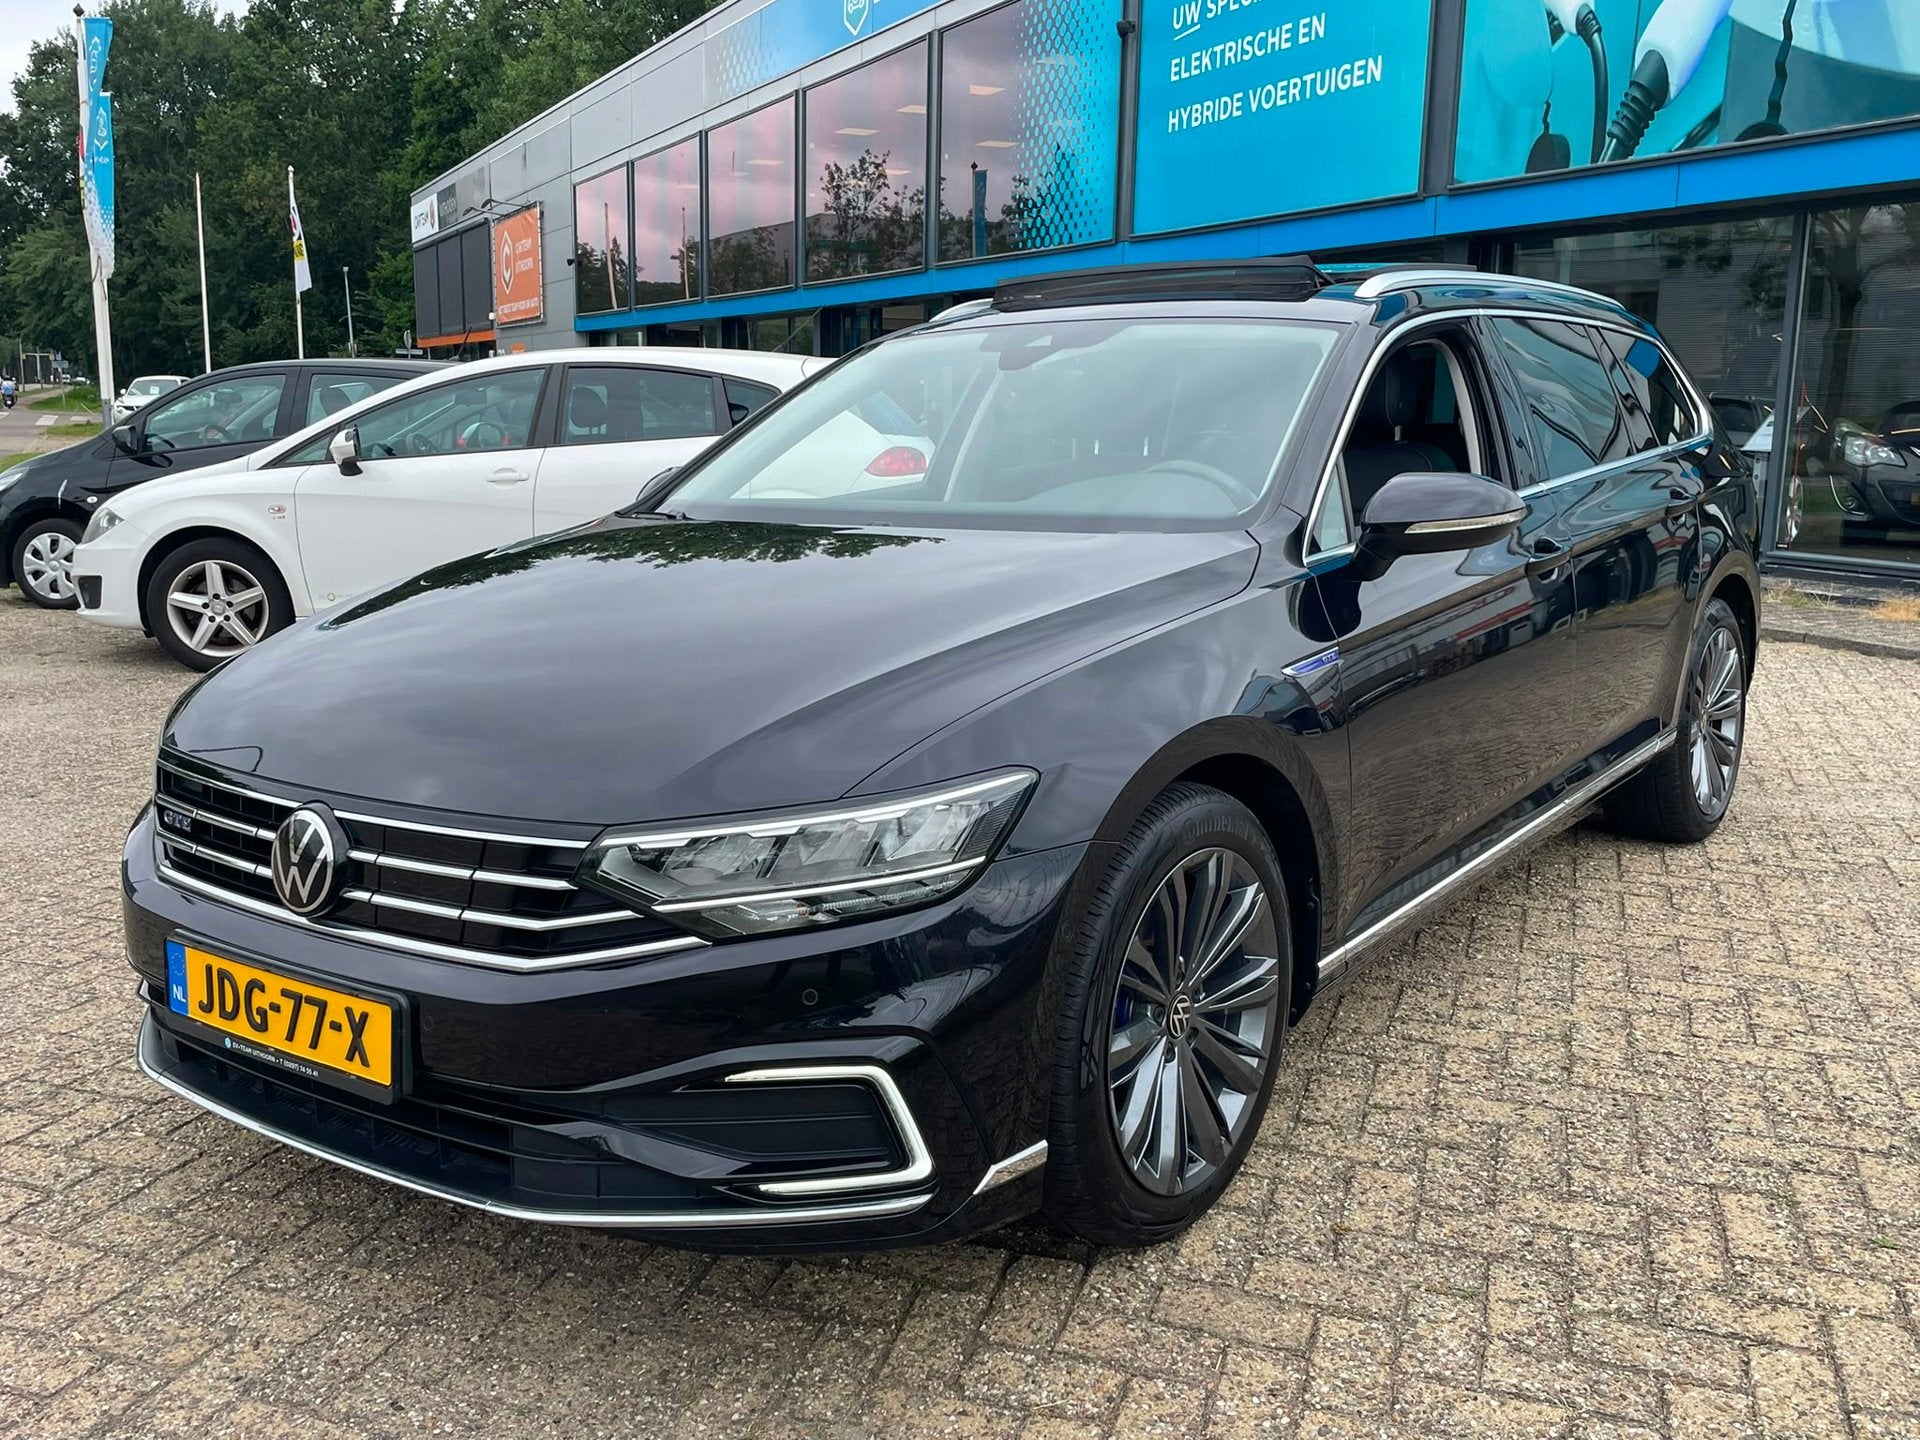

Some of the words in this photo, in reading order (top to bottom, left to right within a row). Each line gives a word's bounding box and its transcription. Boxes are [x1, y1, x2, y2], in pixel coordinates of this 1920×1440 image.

[1173, 0, 1201, 30] UW
[1170, 22, 1293, 82] ELEKTRISCHE
[1298, 12, 1326, 45] EN
[1168, 91, 1244, 133] HYBRIDE
[1248, 54, 1383, 113] VOERTUIGEN
[163, 809, 192, 833] GTE
[172, 983, 187, 1003] NL
[198, 963, 370, 1068] JDG-77-X
